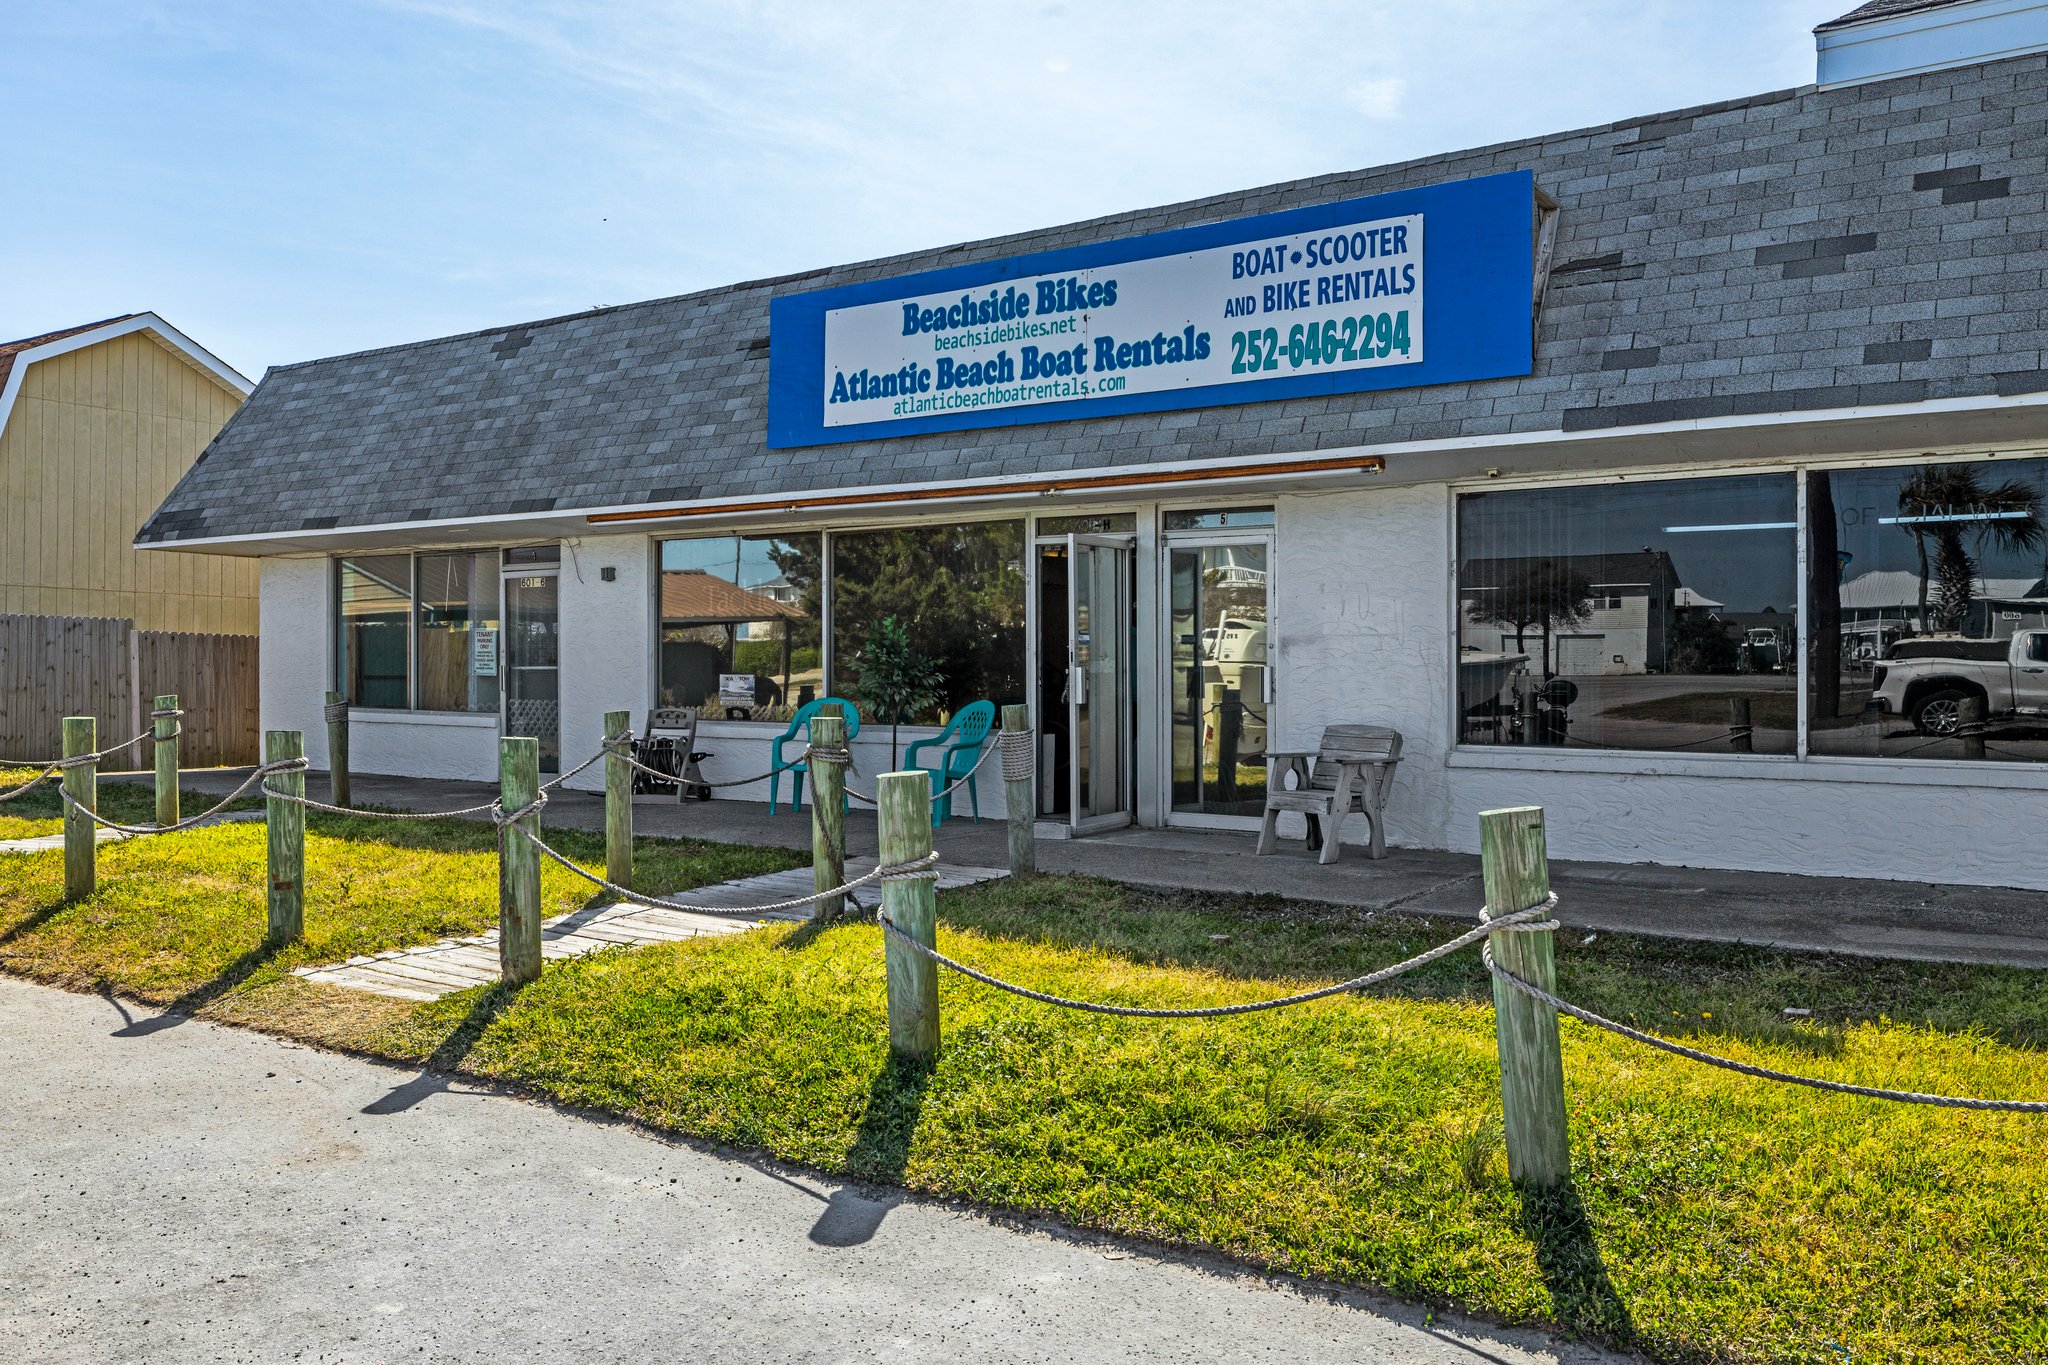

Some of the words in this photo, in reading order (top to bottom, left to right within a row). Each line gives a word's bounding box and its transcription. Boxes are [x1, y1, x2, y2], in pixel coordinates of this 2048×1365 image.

[1233, 244, 1287, 280] BOAT
[1306, 225, 1408, 269] SCOOTER
[901, 286, 1030, 337] Beachside
[1035, 277, 1118, 315] Bikes
[1224, 294, 1257, 318] AND
[1263, 279, 1310, 313] BIKE
[1318, 263, 1415, 306] RENTALS
[934, 315, 1077, 351] beachsidebikes.net
[1231, 310, 1411, 374] 252-646-2294
[829, 361, 931, 404] Atlantic
[935, 350, 1015, 391] Beach
[1020, 343, 1088, 381] Boat
[1093, 324, 1211, 372] Rentals
[893, 375, 1126, 416] atlanticbeachboatrentals.com
[521, 577, 545, 587] 601-6
